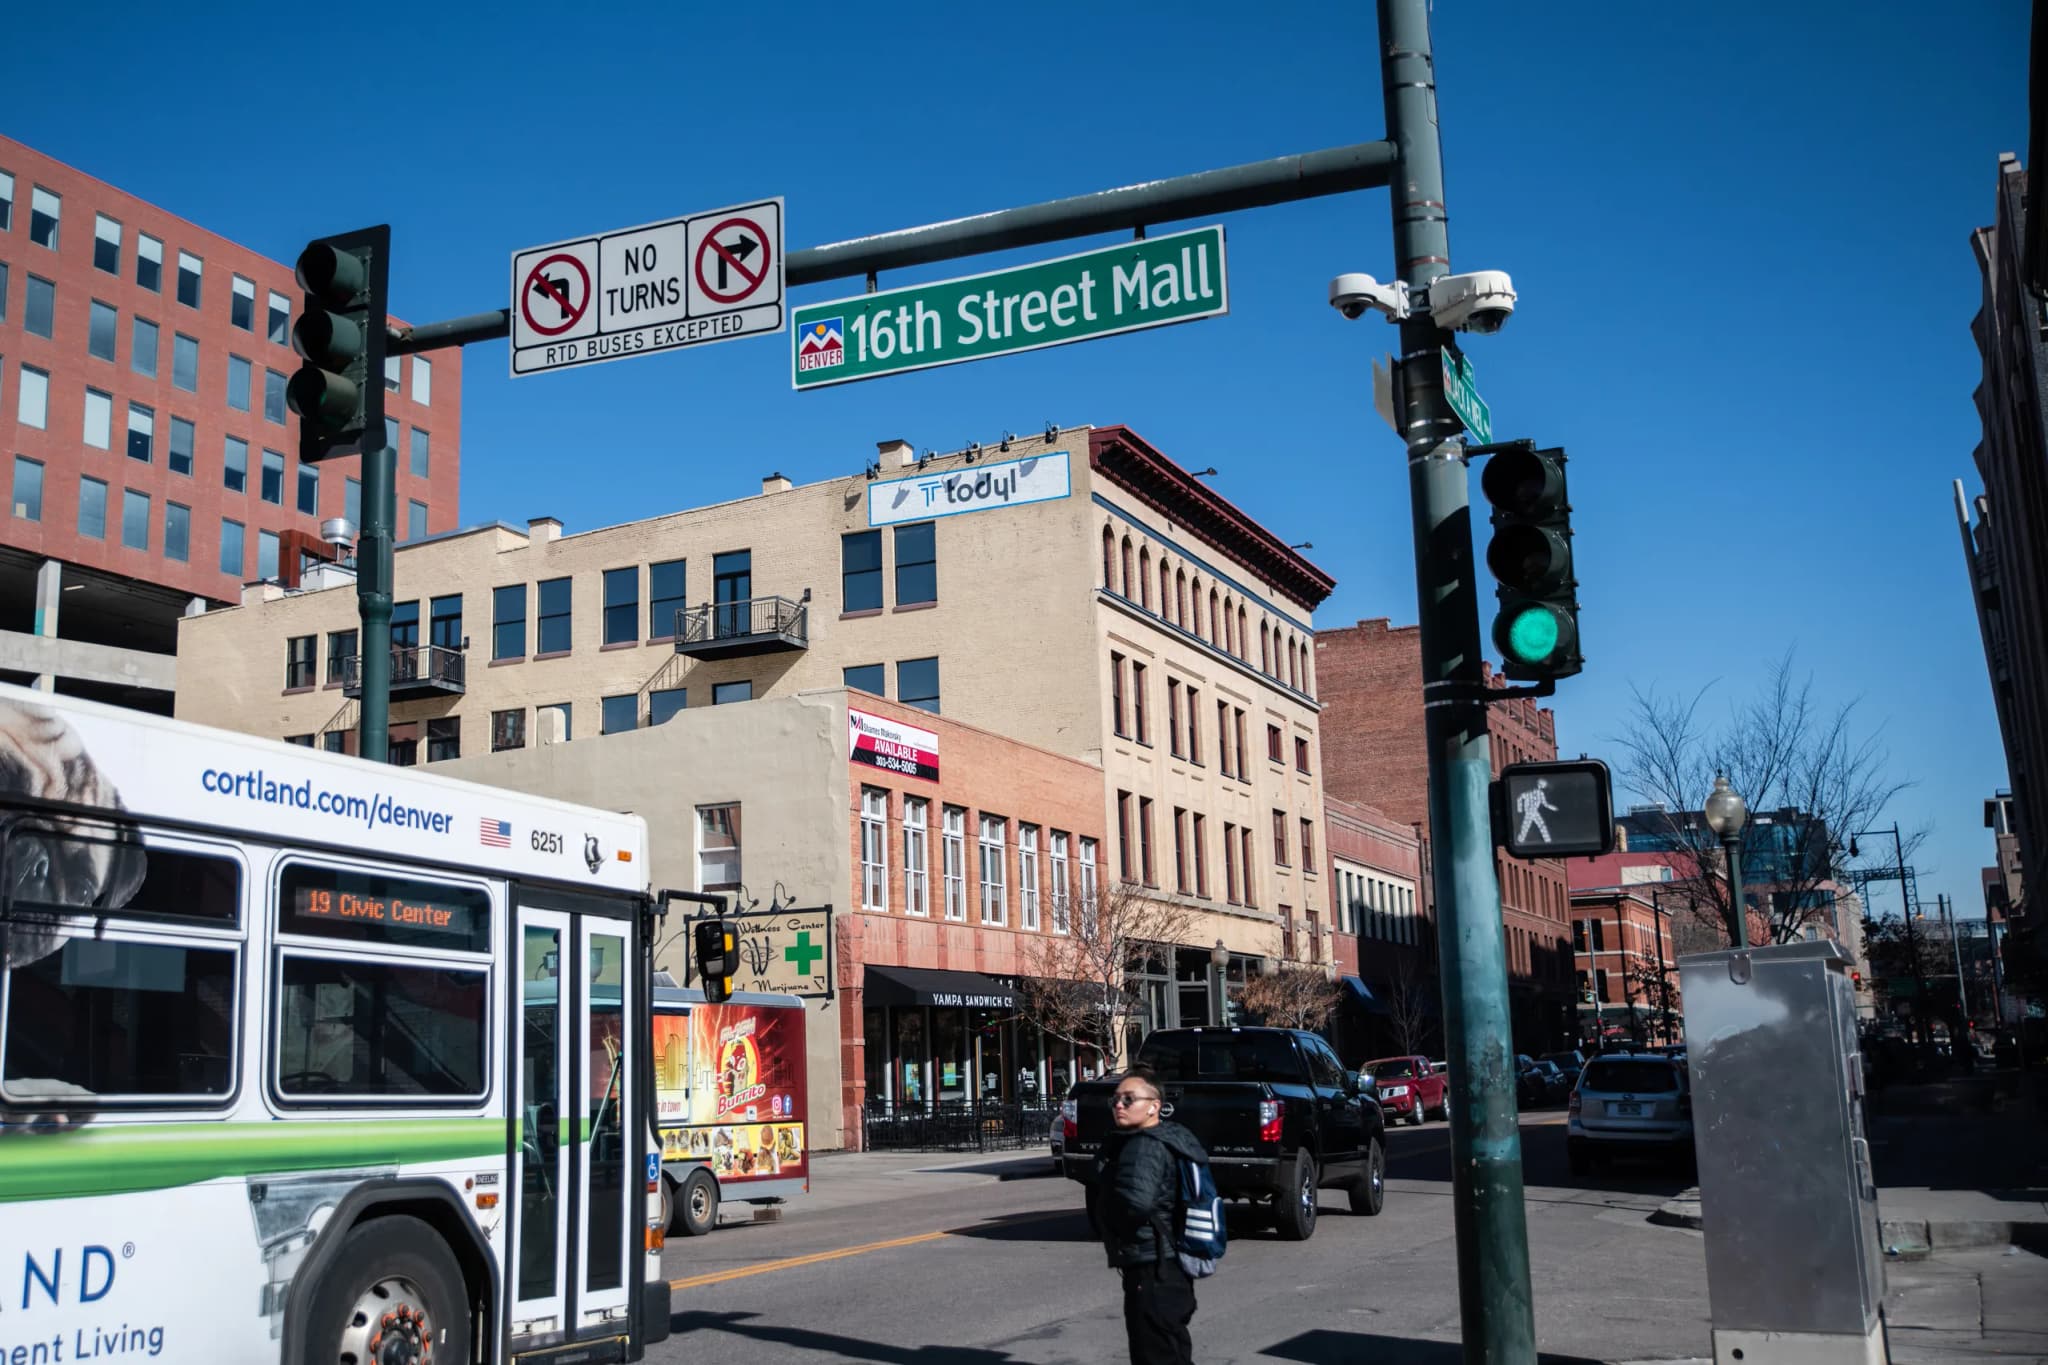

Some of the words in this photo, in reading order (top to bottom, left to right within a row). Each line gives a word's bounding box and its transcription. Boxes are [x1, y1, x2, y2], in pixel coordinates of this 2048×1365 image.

[625, 244, 656, 276] NO
[606, 277, 681, 317] TURNS
[850, 300, 942, 362] 16th
[957, 270, 1097, 346] Street
[1112, 244, 1213, 316] Mall
[546, 343, 578, 365] RTD
[587, 331, 645, 358] BUSES
[653, 314, 744, 346] EXCEPTED
[800, 350, 844, 371] DENVER
[946, 468, 1017, 504] todyl
[873, 738, 918, 762] AVAILABLE
[202, 768, 454, 835] cortland.com/denver
[530, 830, 565, 855] 6251
[309, 889, 331, 914] 19
[339, 892, 385, 921] Civic
[391, 900, 453, 928] Center
[737, 921, 781, 934] Wellness
[786, 918, 825, 931] Center
[752, 979, 809, 994] Marijuana
[932, 993, 963, 1008] YAMPA
[965, 994, 1002, 1008] SANDWICH
[716, 1083, 767, 1117] Burrito
[76, 1323, 164, 1356] Living
